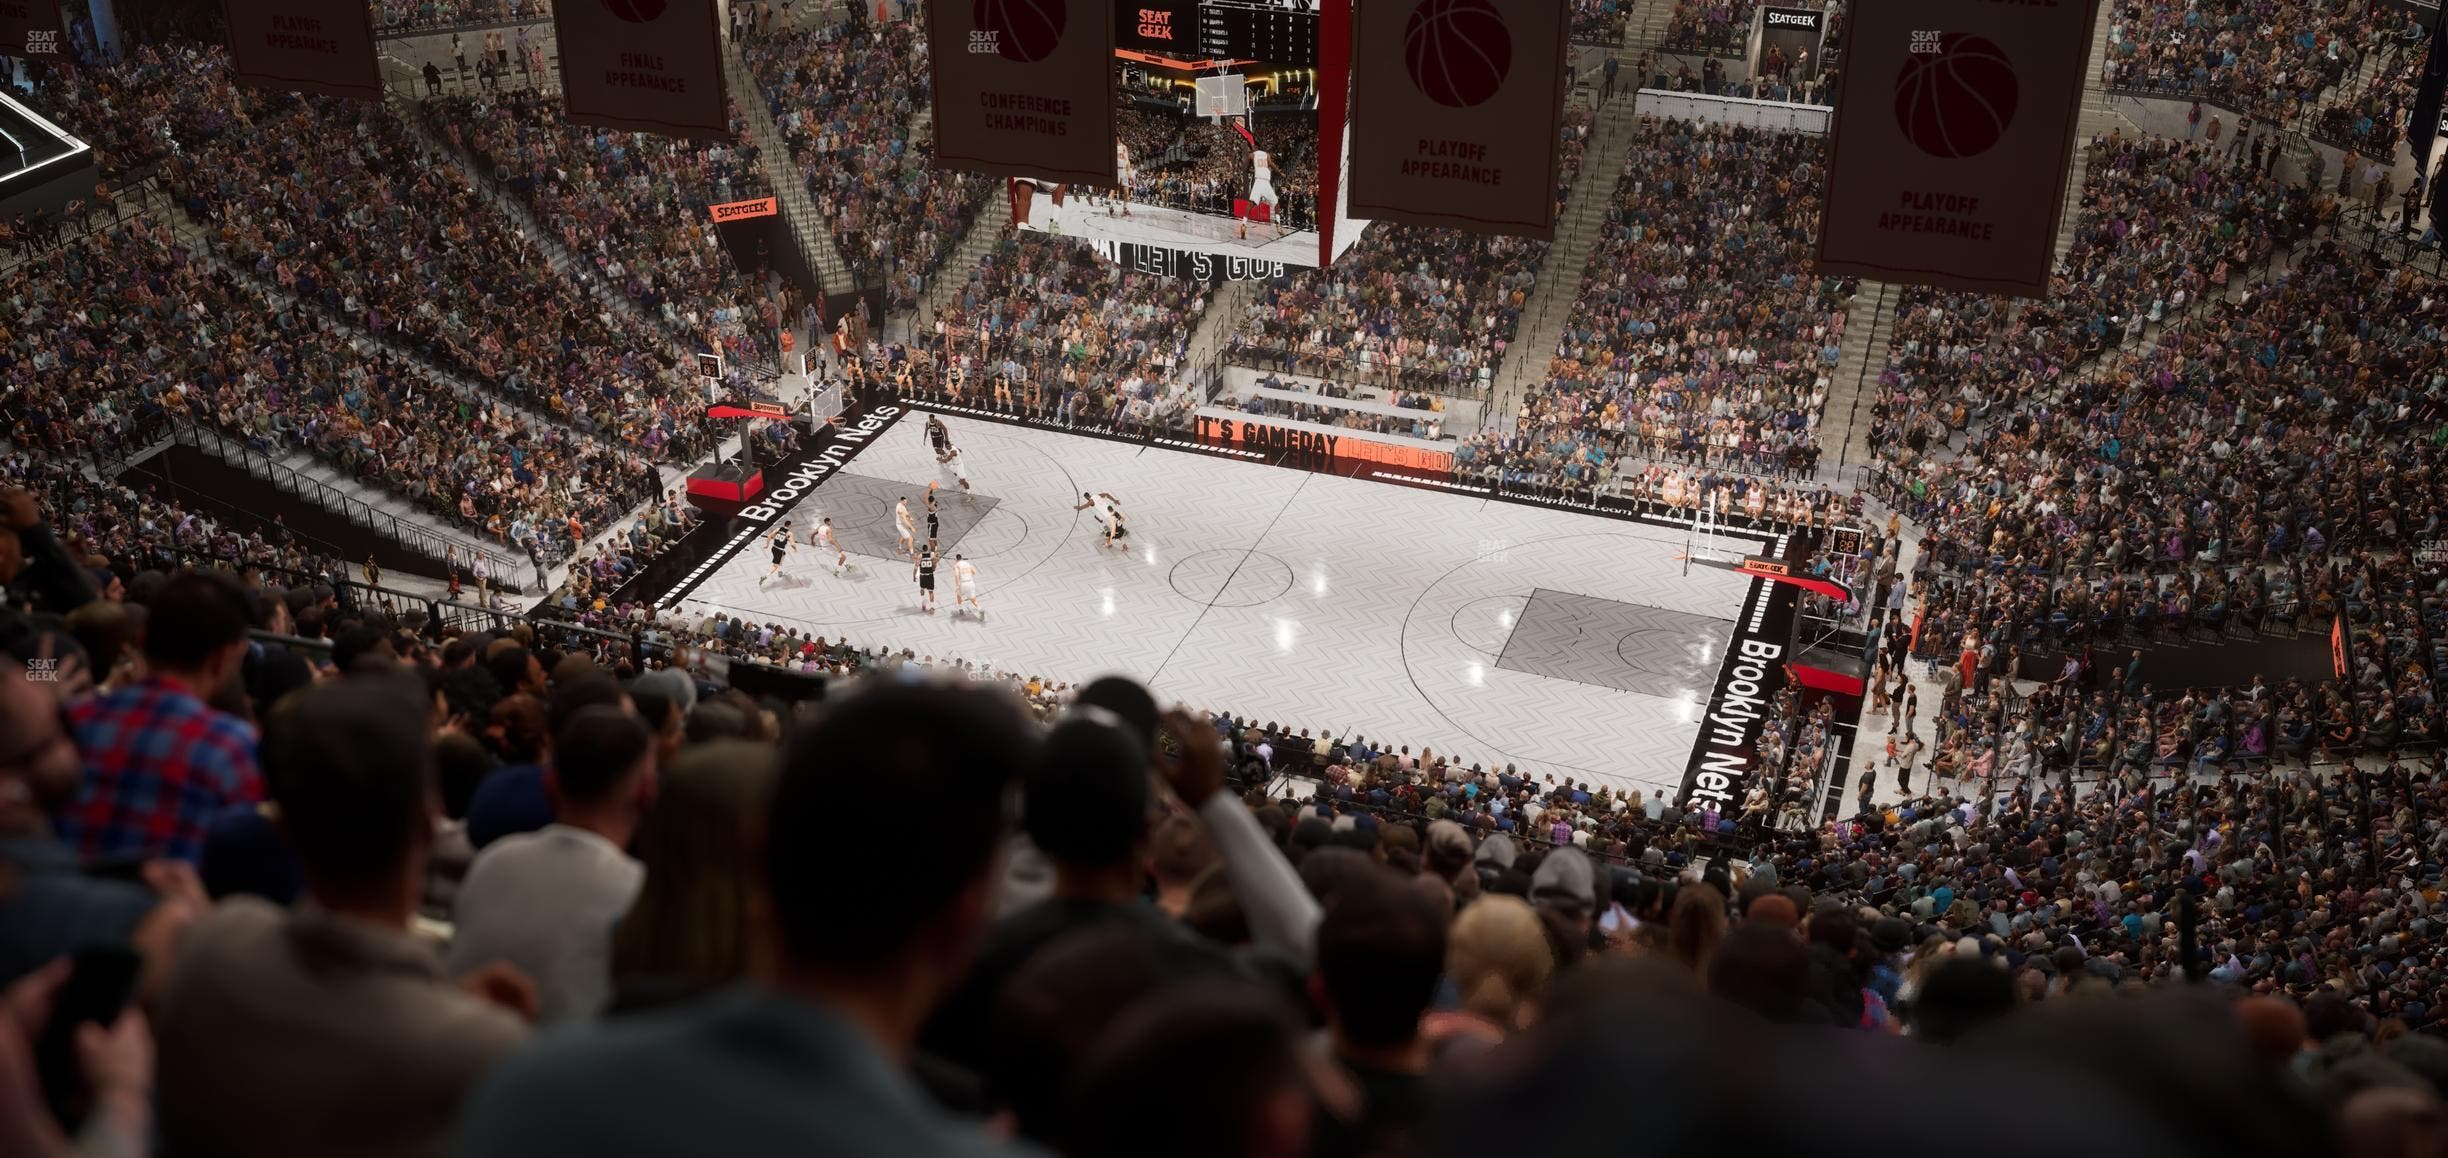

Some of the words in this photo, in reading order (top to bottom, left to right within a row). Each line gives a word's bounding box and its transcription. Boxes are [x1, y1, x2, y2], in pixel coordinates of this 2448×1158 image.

[271, 15, 321, 33] PLAYOFF
[1139, 9, 1172, 25] SEAT
[1768, 12, 1816, 28] SEATGEEK
[1137, 24, 1173, 40] GEEK
[620, 53, 664, 71] FINALS
[606, 71, 687, 93] APPEARANCE
[980, 92, 1071, 116] CONFERENCE
[985, 113, 1067, 136] CHAMPIONS
[1418, 139, 1487, 162] PLAYOFF
[1401, 159, 1502, 185] APPEARANCE
[717, 200, 769, 218] SEATGEEK
[1902, 191, 1979, 215] PLAYOFF
[1878, 213, 1994, 241] APPEARANCE
[1193, 415, 1233, 438] IT'S
[1243, 423, 1338, 456] GAMEDAY
[737, 444, 854, 521] Brooklyn
[837, 403, 899, 443] Nets
[1709, 639, 1783, 747] Brooklyn
